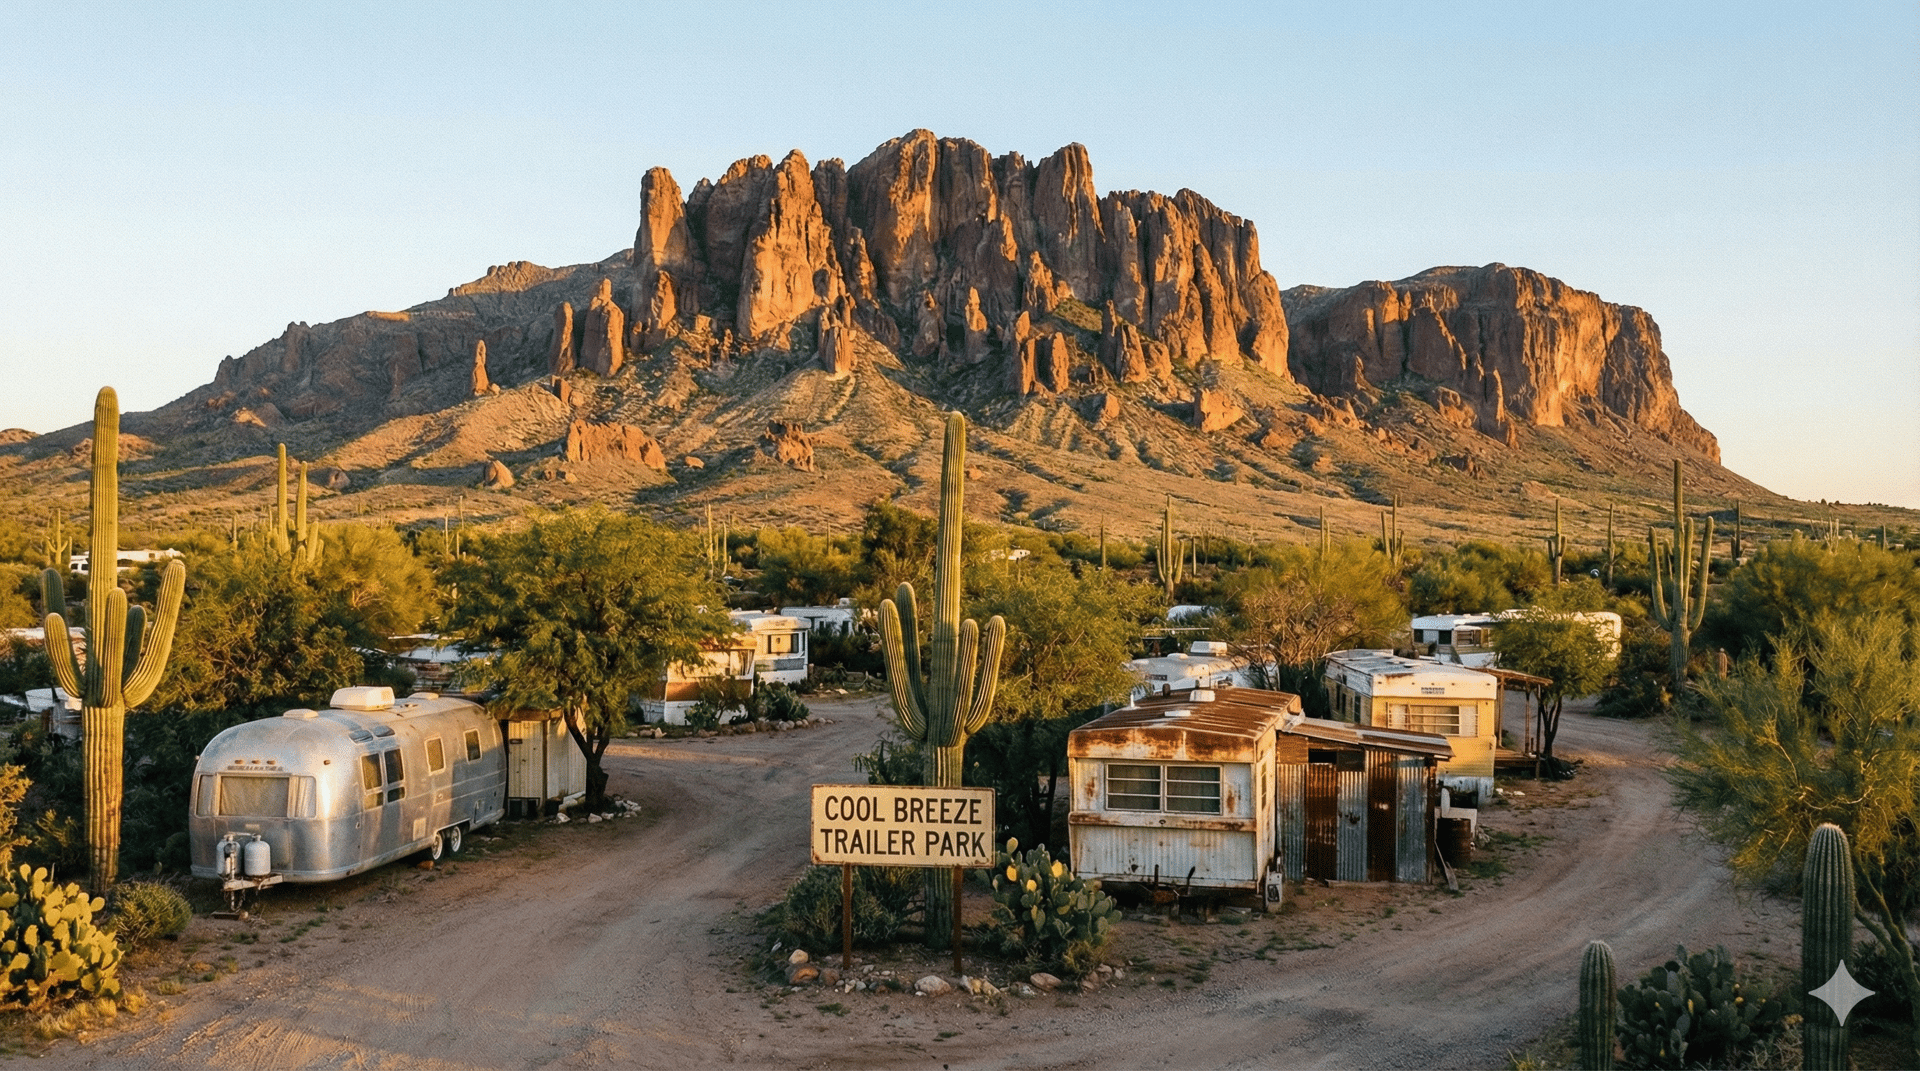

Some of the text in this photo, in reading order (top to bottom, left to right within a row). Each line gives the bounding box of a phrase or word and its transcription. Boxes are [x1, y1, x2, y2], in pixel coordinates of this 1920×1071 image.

[825, 796, 982, 824] COOL BREEZE
[820, 829, 986, 857] TRAILER PARK
